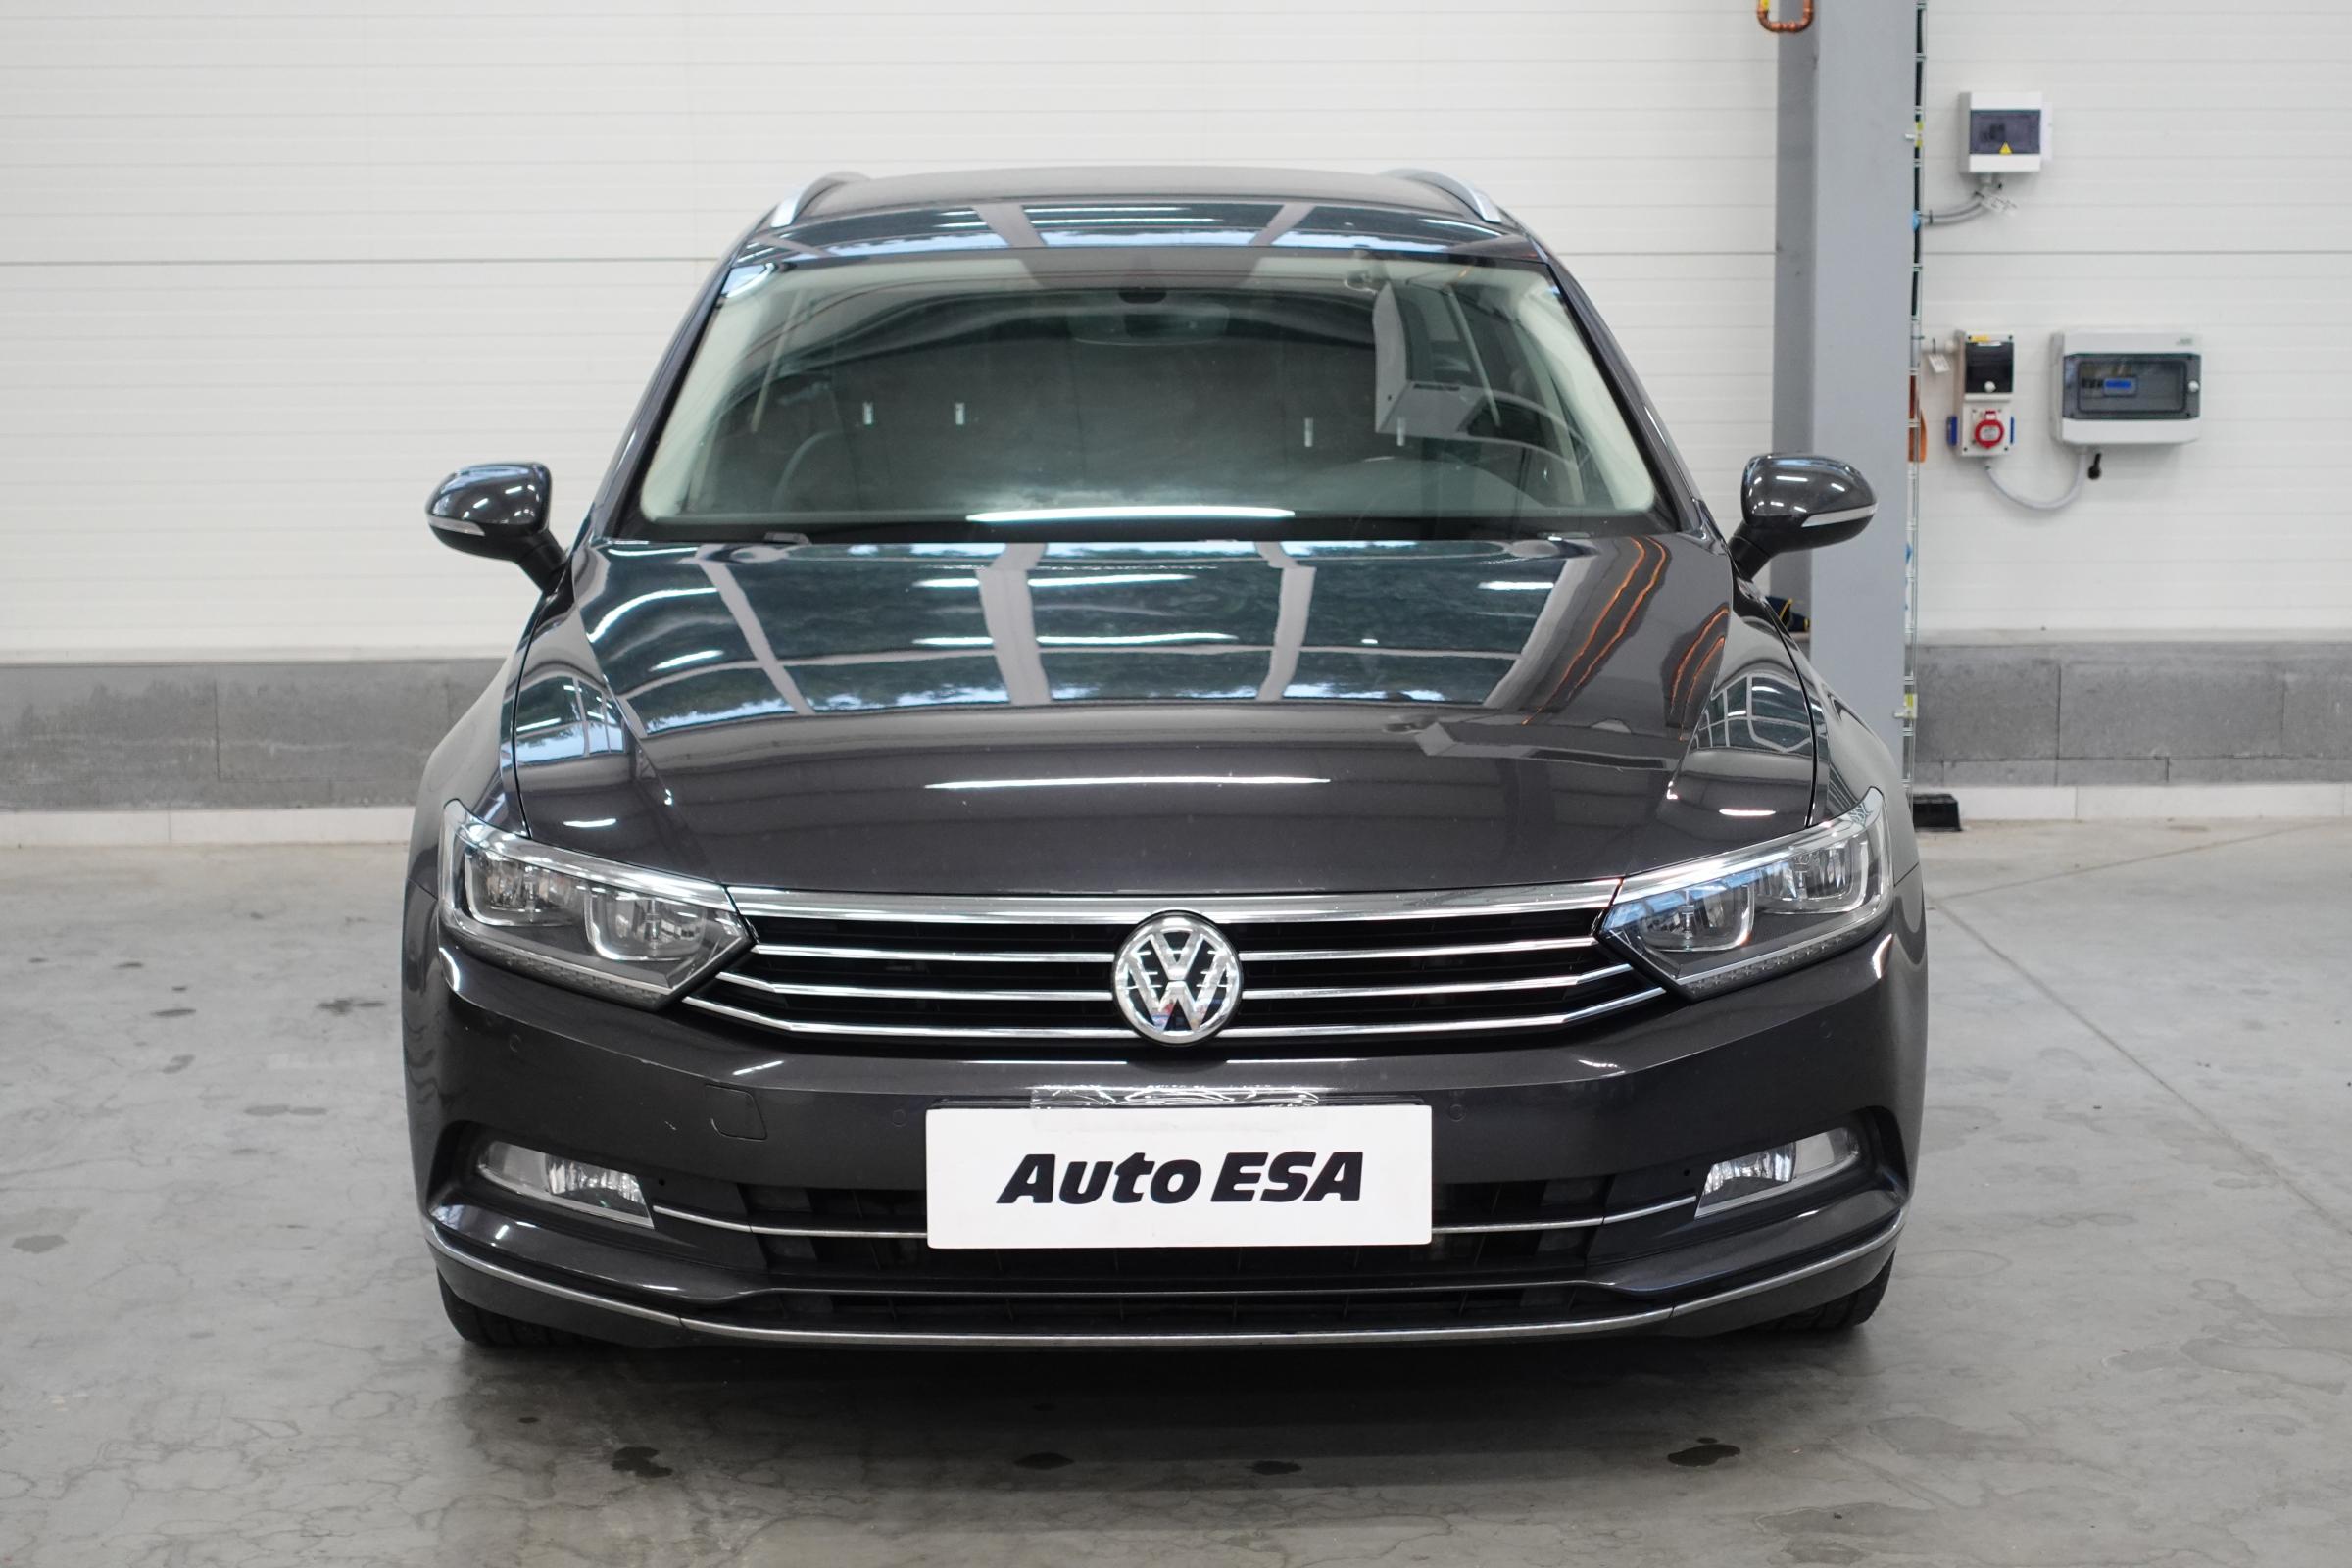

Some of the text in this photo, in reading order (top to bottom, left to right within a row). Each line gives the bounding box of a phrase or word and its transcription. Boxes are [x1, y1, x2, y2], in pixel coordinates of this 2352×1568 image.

[1118, 919, 1236, 1039] VW
[996, 1151, 1364, 1205] Auto ESA
